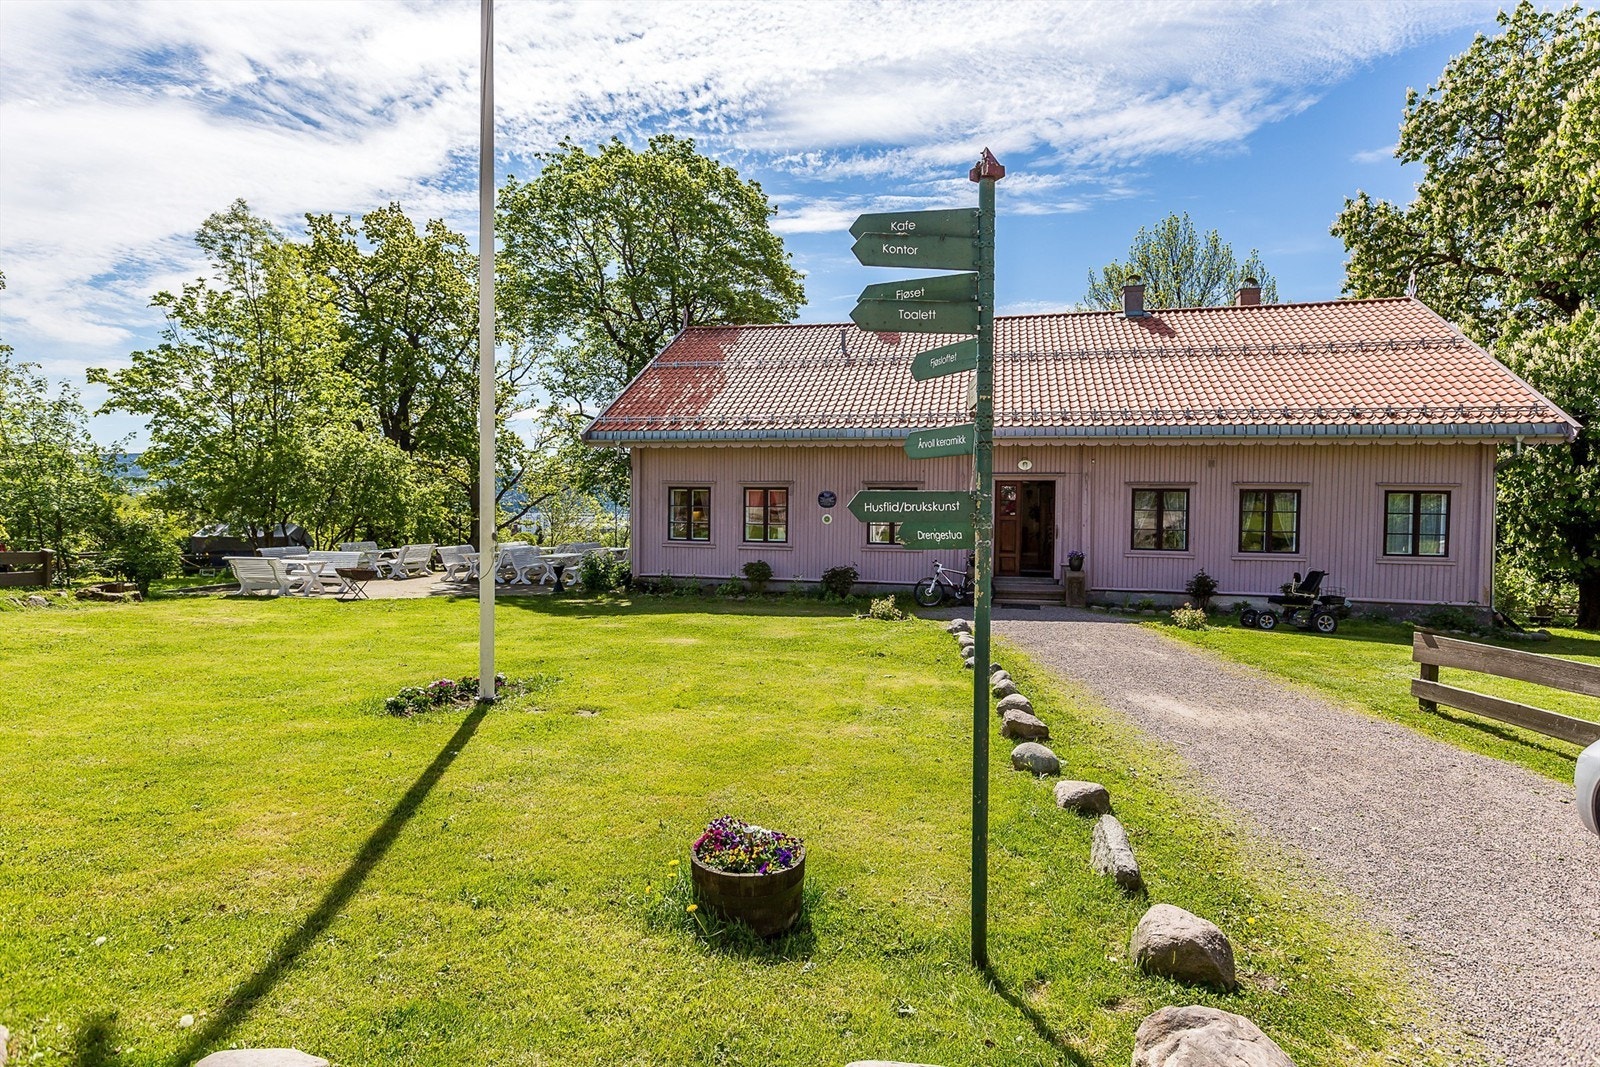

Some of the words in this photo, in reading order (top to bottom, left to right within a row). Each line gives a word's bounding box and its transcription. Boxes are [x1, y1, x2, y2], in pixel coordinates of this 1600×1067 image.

[890, 220, 916, 231] Kafe
[882, 243, 919, 255] Kontor
[896, 287, 925, 300] Fjøset
[898, 309, 937, 320] Toalett
[930, 352, 957, 369] Fjøsloftet
[936, 435, 966, 447] keramikk
[864, 501, 960, 513] Husflid/brukskunst
[917, 530, 963, 542] Drengestua
